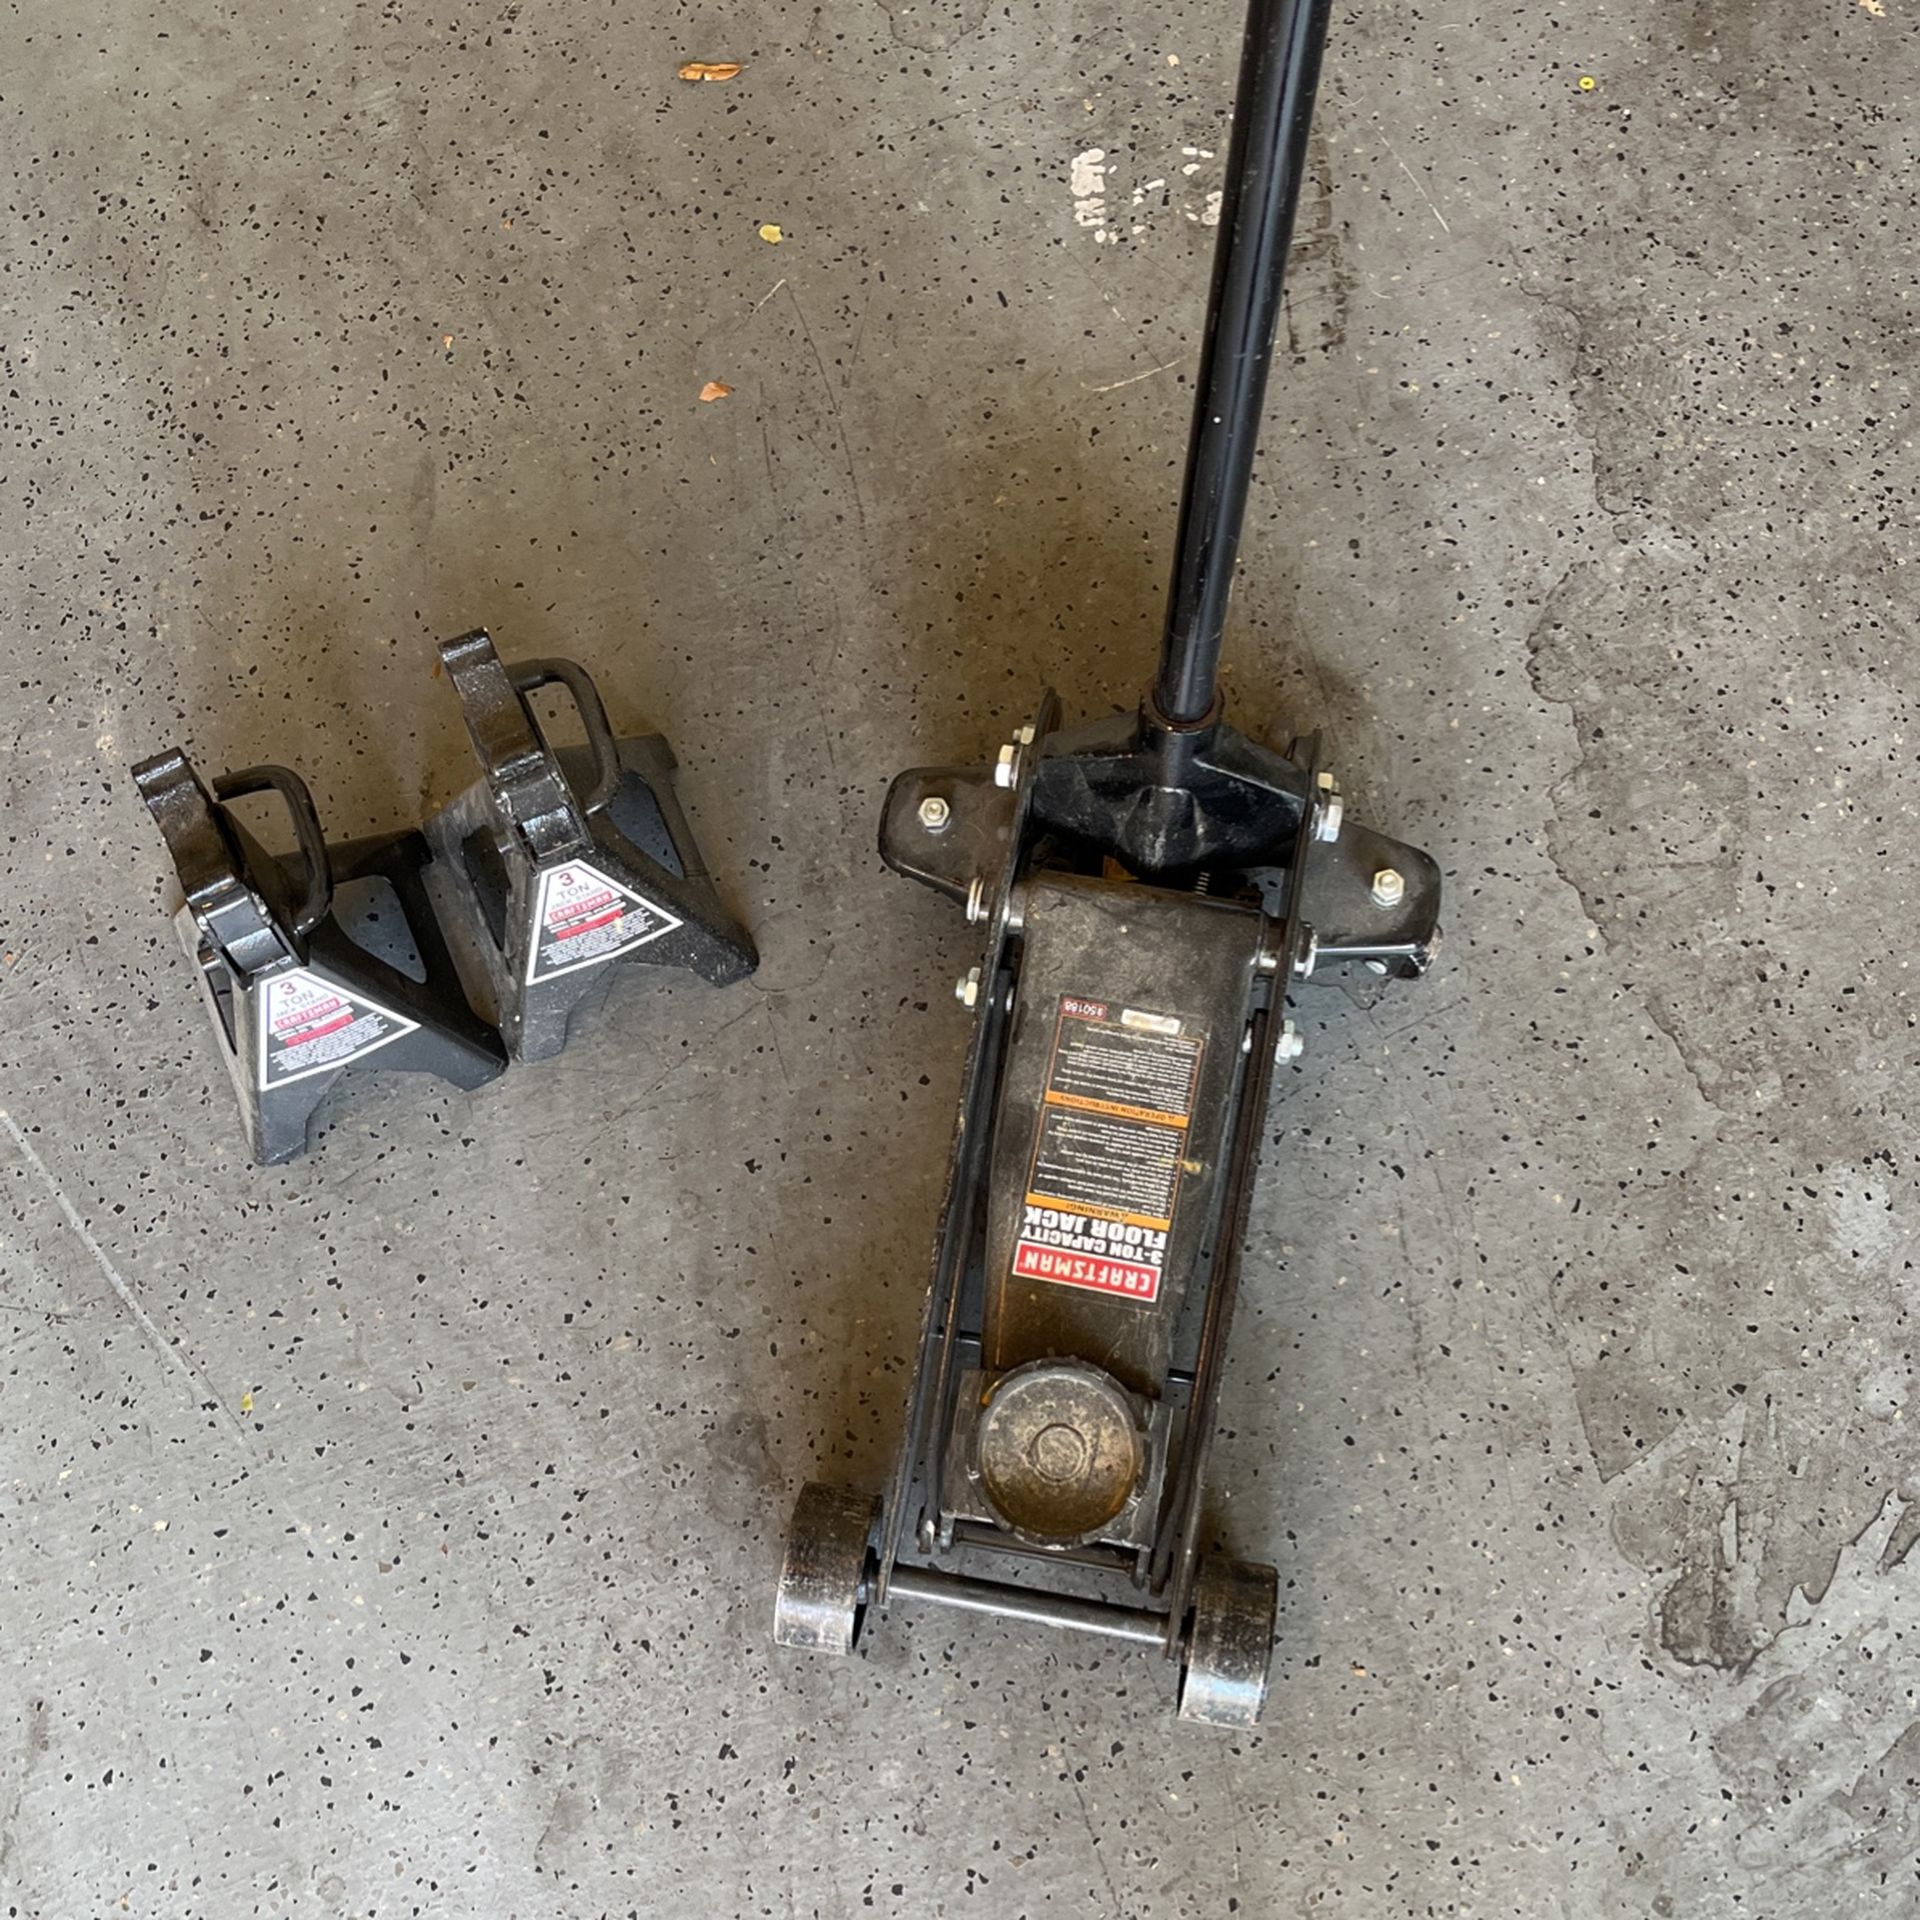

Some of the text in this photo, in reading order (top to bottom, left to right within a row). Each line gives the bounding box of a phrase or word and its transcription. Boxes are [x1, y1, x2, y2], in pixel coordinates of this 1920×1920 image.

[559, 882, 589, 899] TON
[560, 873, 574, 886] 3
[550, 893, 611, 920] CRAFTSMAN
[280, 982, 296, 996] 3
[281, 989, 313, 1007] TON
[277, 999, 339, 1028] CRAFTSMAN
[1060, 1095, 1165, 1120] OPERATION INSTRUCTIONS
[1065, 1202, 1120, 1218] WARNING!
[1023, 1206, 1166, 1248] FLOOR JACK
[1020, 1225, 1163, 1264] 3-TON CAPACITY
[1023, 1250, 1150, 1292] CRAFTSMAN
